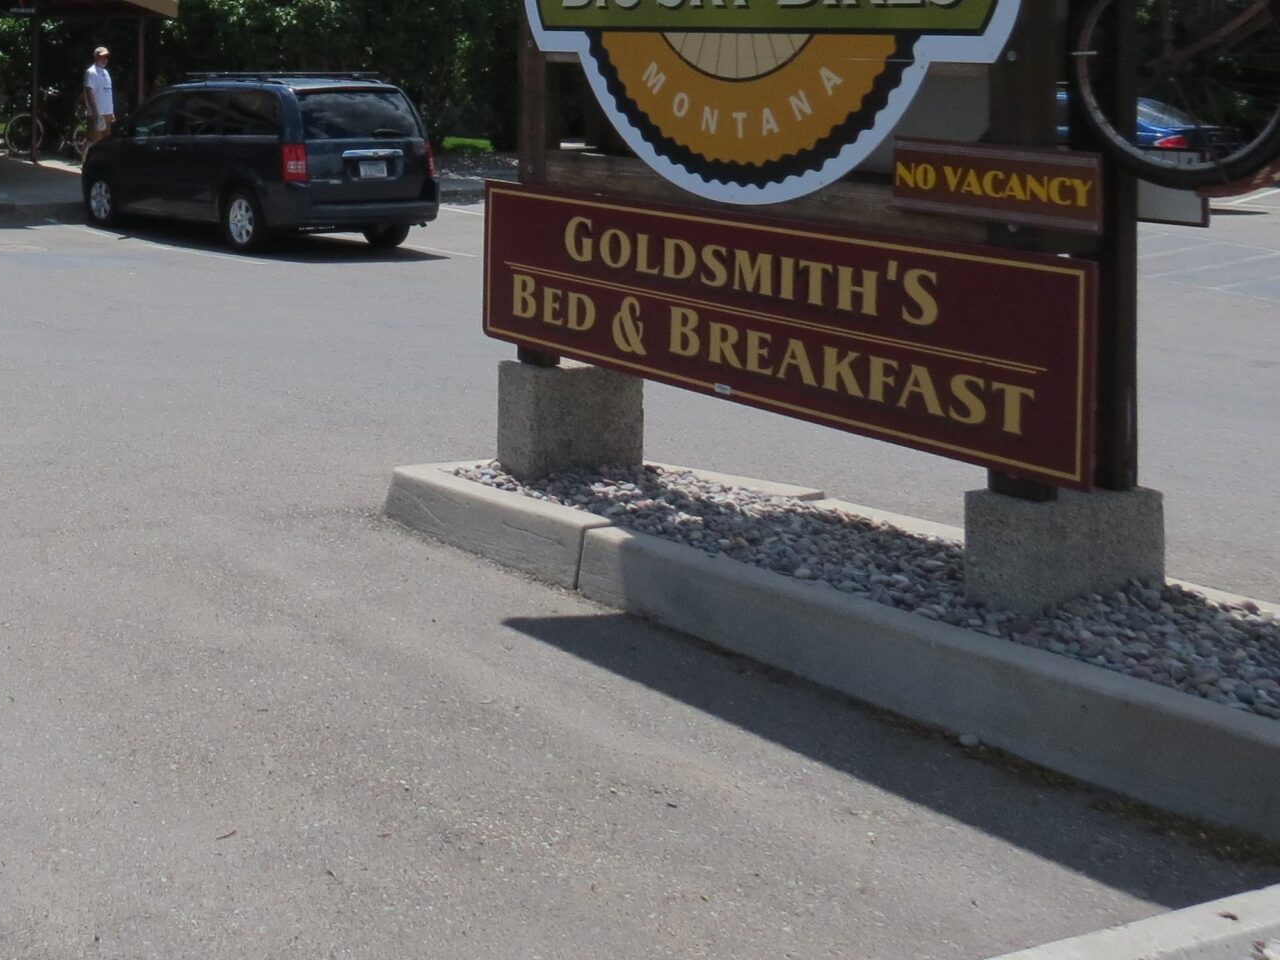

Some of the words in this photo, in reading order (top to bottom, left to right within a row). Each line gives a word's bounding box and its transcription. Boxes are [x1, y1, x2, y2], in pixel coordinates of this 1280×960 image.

[641, 61, 844, 139] MONTANA
[895, 161, 937, 190] NO
[943, 166, 1093, 207] VACANCY
[564, 215, 940, 327] GOLDSMITH'S
[511, 273, 596, 331] BED
[612, 296, 648, 356] &
[669, 305, 1036, 436] BREAKFAST
